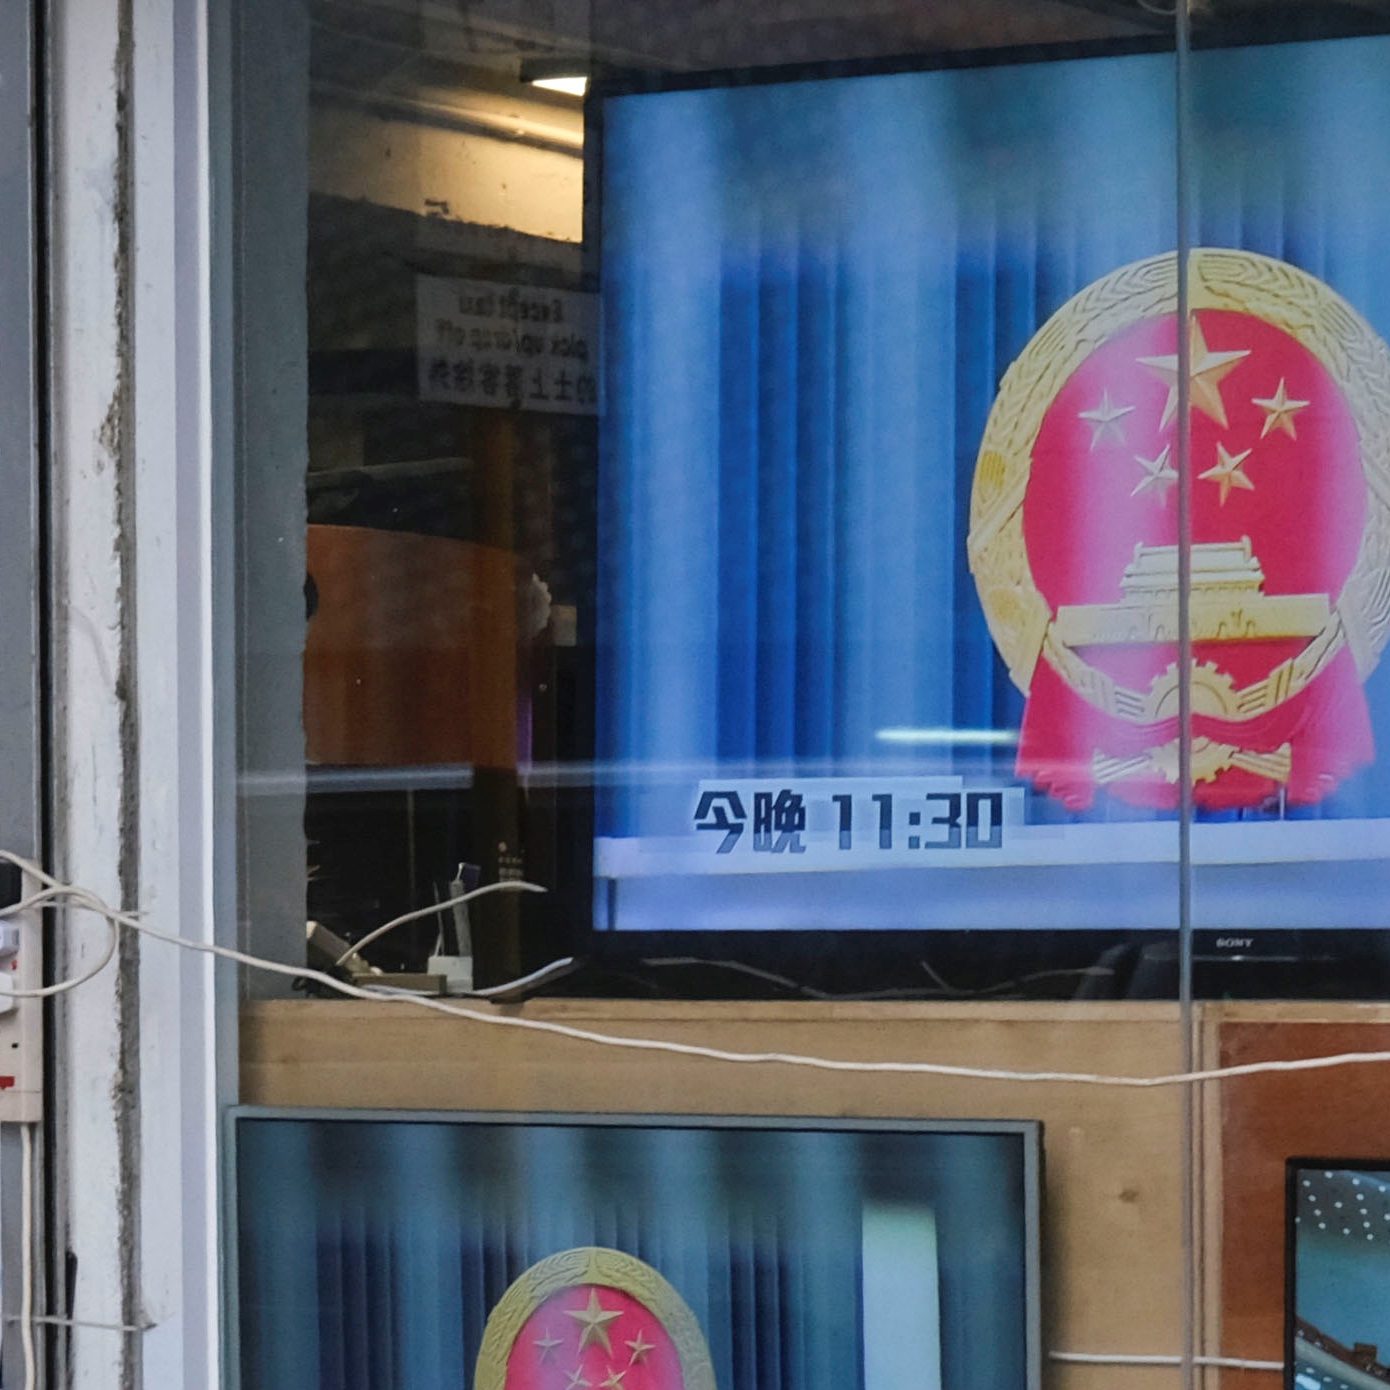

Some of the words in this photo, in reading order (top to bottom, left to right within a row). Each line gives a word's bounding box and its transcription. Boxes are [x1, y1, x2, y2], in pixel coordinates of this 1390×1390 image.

[693, 788, 807, 854] 今晚
[832, 791, 1004, 850] 11:30
[1215, 937, 1255, 949] SONY
